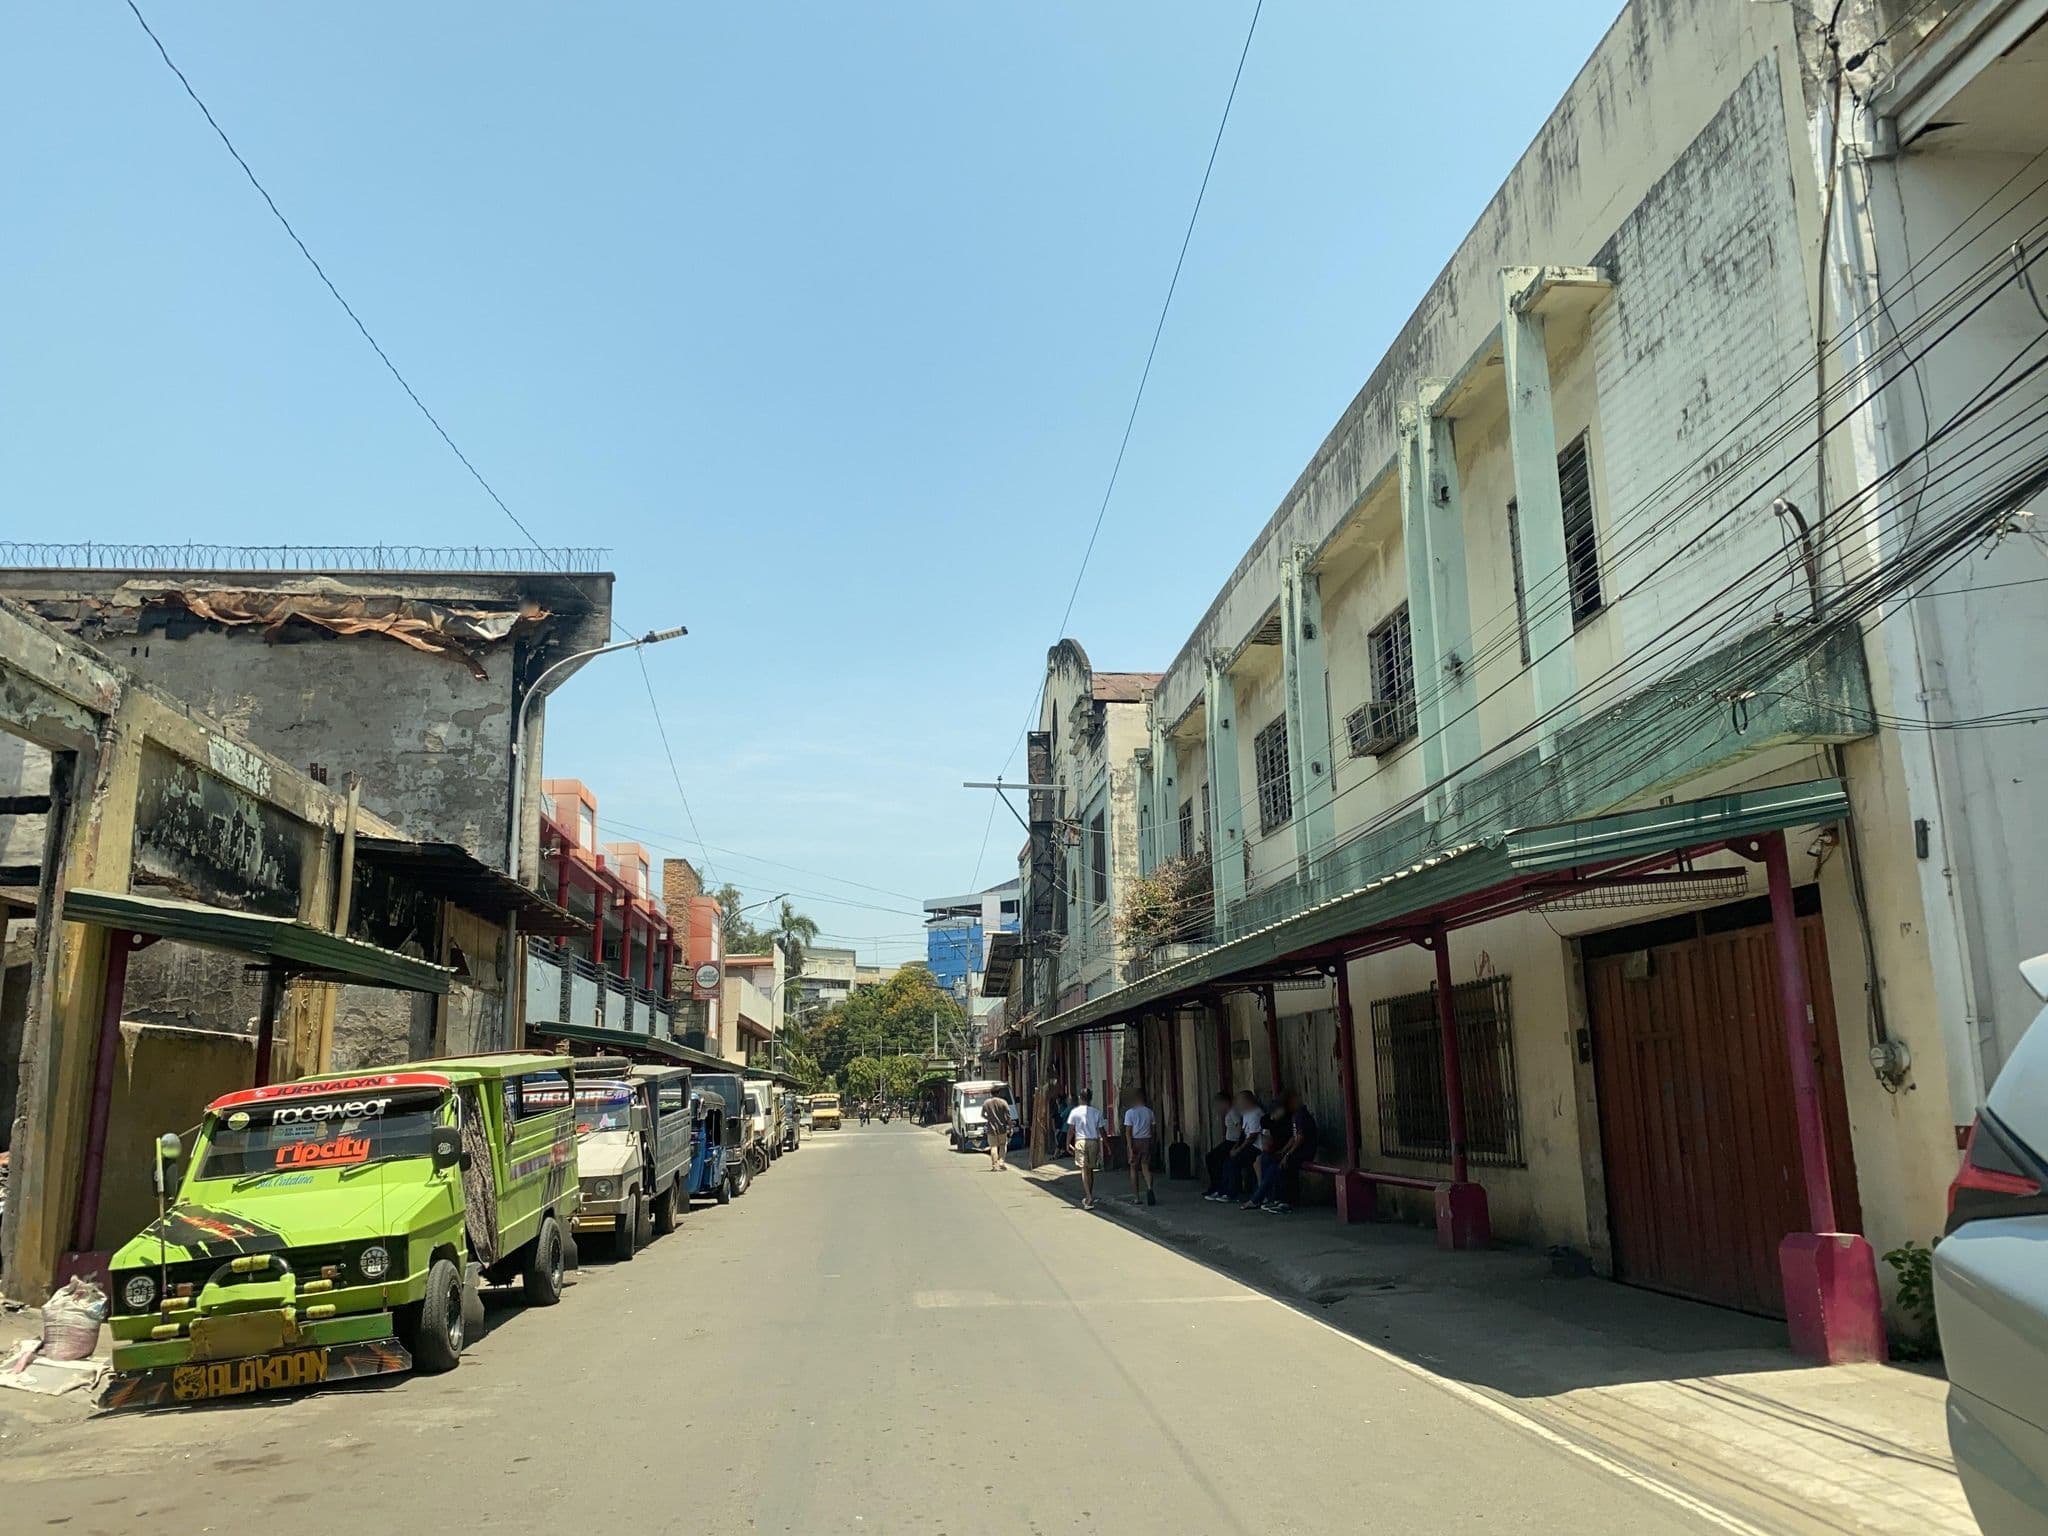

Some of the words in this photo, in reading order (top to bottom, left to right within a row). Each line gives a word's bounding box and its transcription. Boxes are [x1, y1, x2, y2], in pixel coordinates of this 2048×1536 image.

[268, 1077, 382, 1096] JURNALYN
[272, 1098, 392, 1126] racewear
[274, 1136, 371, 1168] ripcity
[207, 1350, 328, 1397] ALAKDAN
